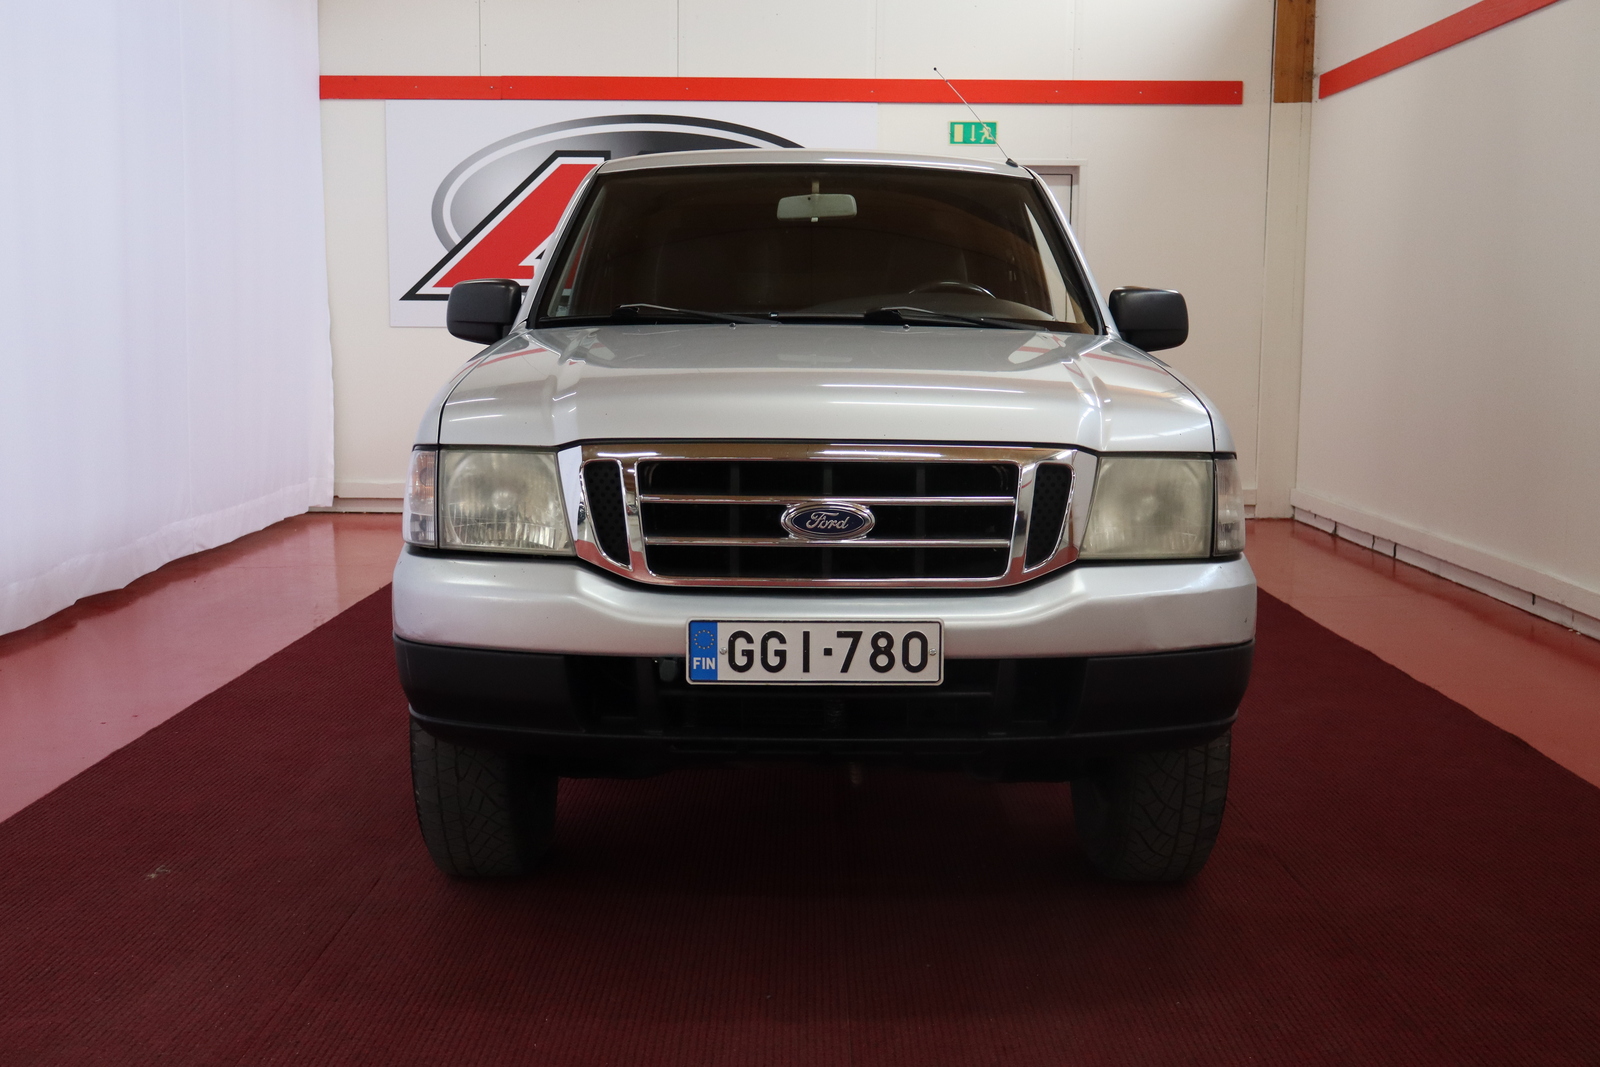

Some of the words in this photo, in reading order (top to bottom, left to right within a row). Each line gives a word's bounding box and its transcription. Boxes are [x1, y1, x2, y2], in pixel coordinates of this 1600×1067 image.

[805, 511, 850, 530] Ford
[728, 630, 929, 674] GGI-780
[693, 657, 716, 670] FIN
